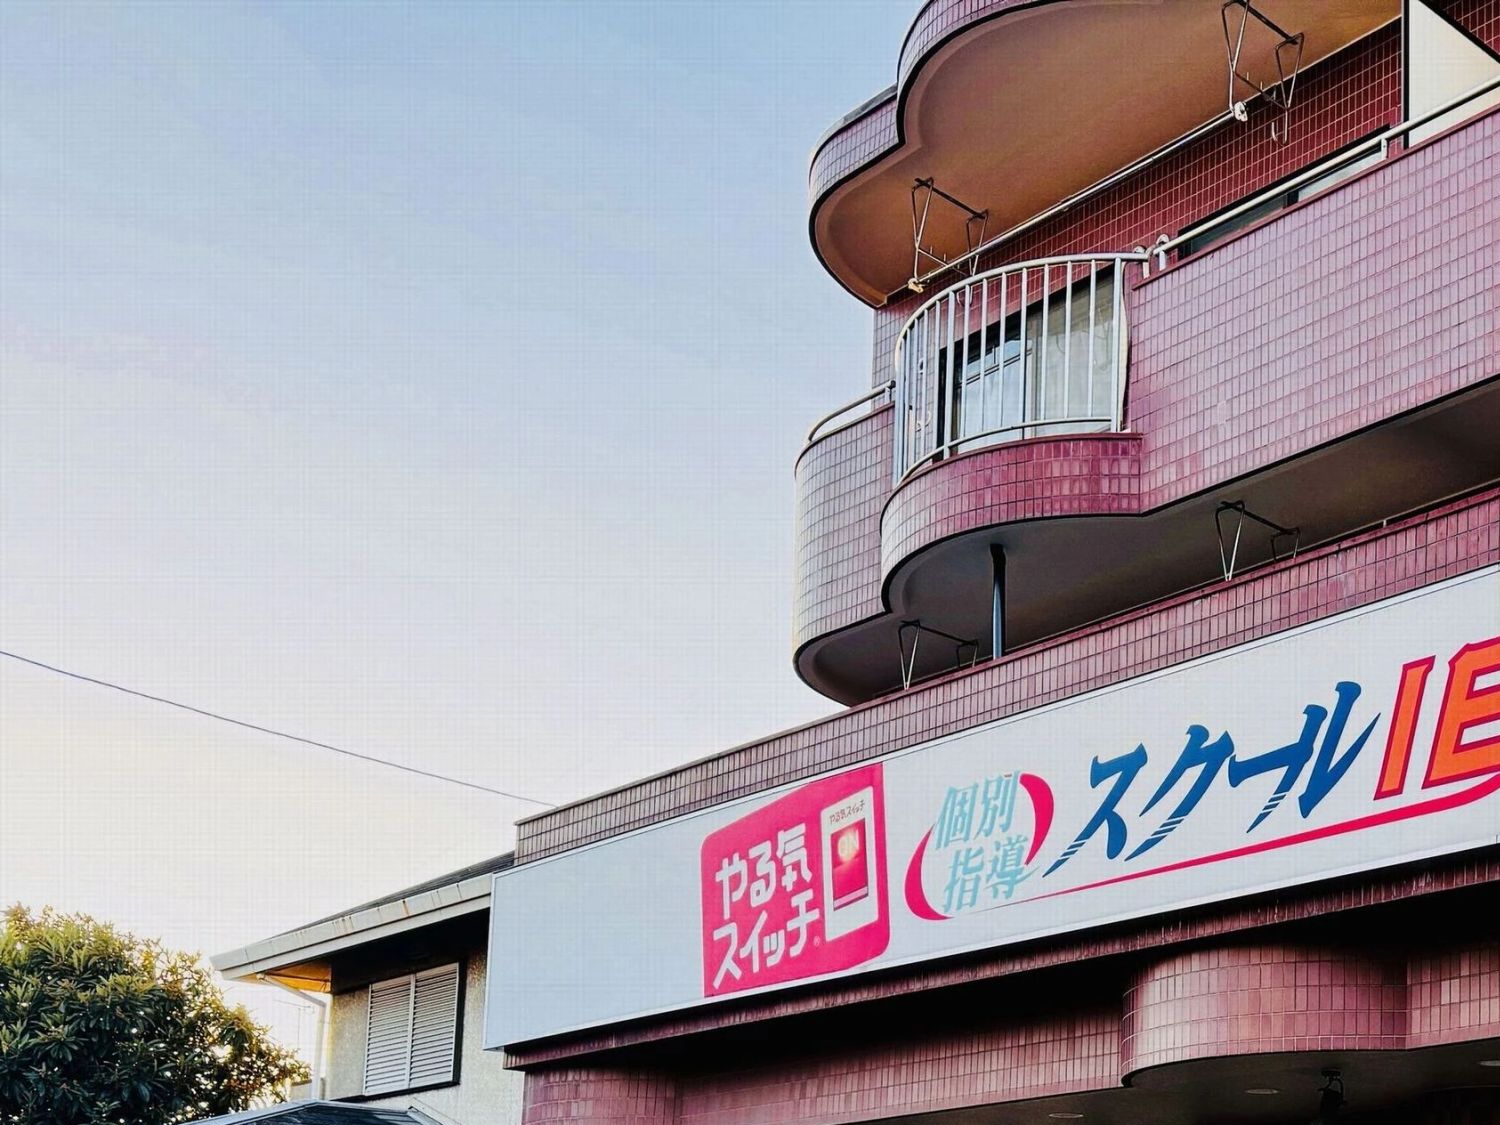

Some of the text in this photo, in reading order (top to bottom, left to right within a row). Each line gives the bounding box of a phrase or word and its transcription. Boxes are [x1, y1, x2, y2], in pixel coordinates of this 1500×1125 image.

[829, 797, 866, 826] やる気スイッチ
[935, 770, 1021, 848] 個別
[714, 822, 813, 919] やる気
[941, 836, 1033, 911] 指導
[713, 890, 820, 988] スイッチ
